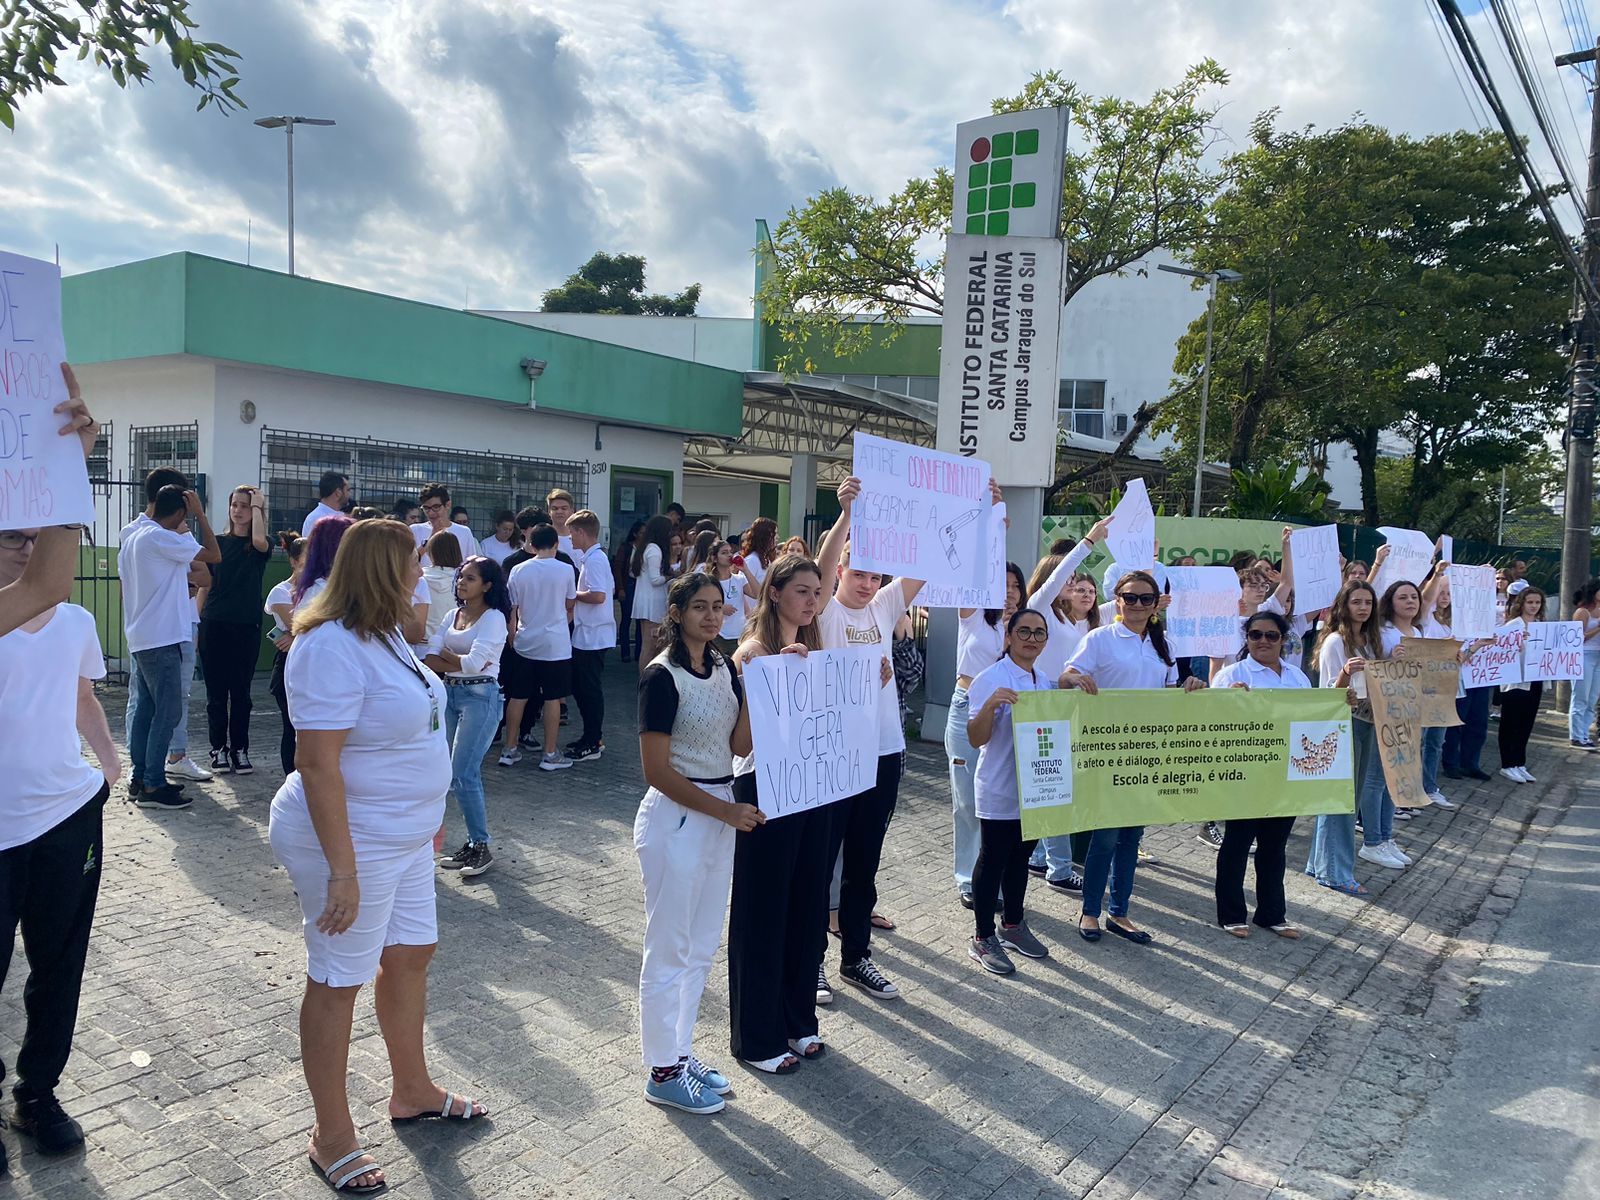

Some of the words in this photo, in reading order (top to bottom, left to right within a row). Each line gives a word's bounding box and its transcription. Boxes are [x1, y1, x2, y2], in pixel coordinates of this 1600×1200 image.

[1019, 252, 1036, 278] Sul
[965, 250, 987, 349] FEDERAL
[991, 251, 1013, 343] CATARINA
[1017, 283, 1034, 302] do
[1014, 309, 1035, 374] Jaraguá
[987, 349, 1008, 410] SANTA
[959, 355, 982, 457] NSTITUTO
[1009, 378, 1032, 442] Campus
[860, 444, 900, 476] ATIRE
[853, 491, 919, 528] DESARME
[926, 505, 938, 530] A
[1471, 666, 1503, 684] PAZ
[1538, 651, 1582, 678] ARMAS
[761, 653, 872, 717] VIOLÊNCIA
[798, 710, 845, 761] GERA
[1082, 725, 1088, 735] A
[1090, 724, 1120, 734] escola
[1123, 723, 1129, 733] é
[1140, 725, 1174, 735] espaço
[1176, 724, 1198, 735] para
[1208, 721, 1260, 733] construção
[1262, 721, 1274, 731] de
[1071, 741, 1116, 753] diferentes
[1119, 740, 1159, 750] saberes,
[1161, 738, 1167, 748] é
[1169, 738, 1201, 748] ensino
[1204, 740, 1210, 748] e
[1212, 737, 1218, 747] é
[1220, 736, 1287, 749] aprendizagem,
[1031, 759, 1062, 768] INSTITUTO
[1034, 767, 1060, 776] FEDERAL
[1077, 758, 1082, 769] é
[1083, 757, 1105, 768] afeto
[1108, 759, 1114, 767] e
[1117, 756, 1123, 766] é
[1125, 755, 1163, 768] diálogo,
[1165, 754, 1171, 764] é
[1174, 754, 1213, 766] respeito
[1224, 751, 1281, 764] colaboração.
[766, 748, 861, 814] VIOLÊNCIA
[1113, 773, 1149, 786] Escola
[1152, 772, 1159, 783] é
[1162, 770, 1205, 786] alegria,
[1208, 769, 1215, 781] é
[1218, 769, 1246, 781] vida.
[1183, 787, 1199, 795] 1993)
